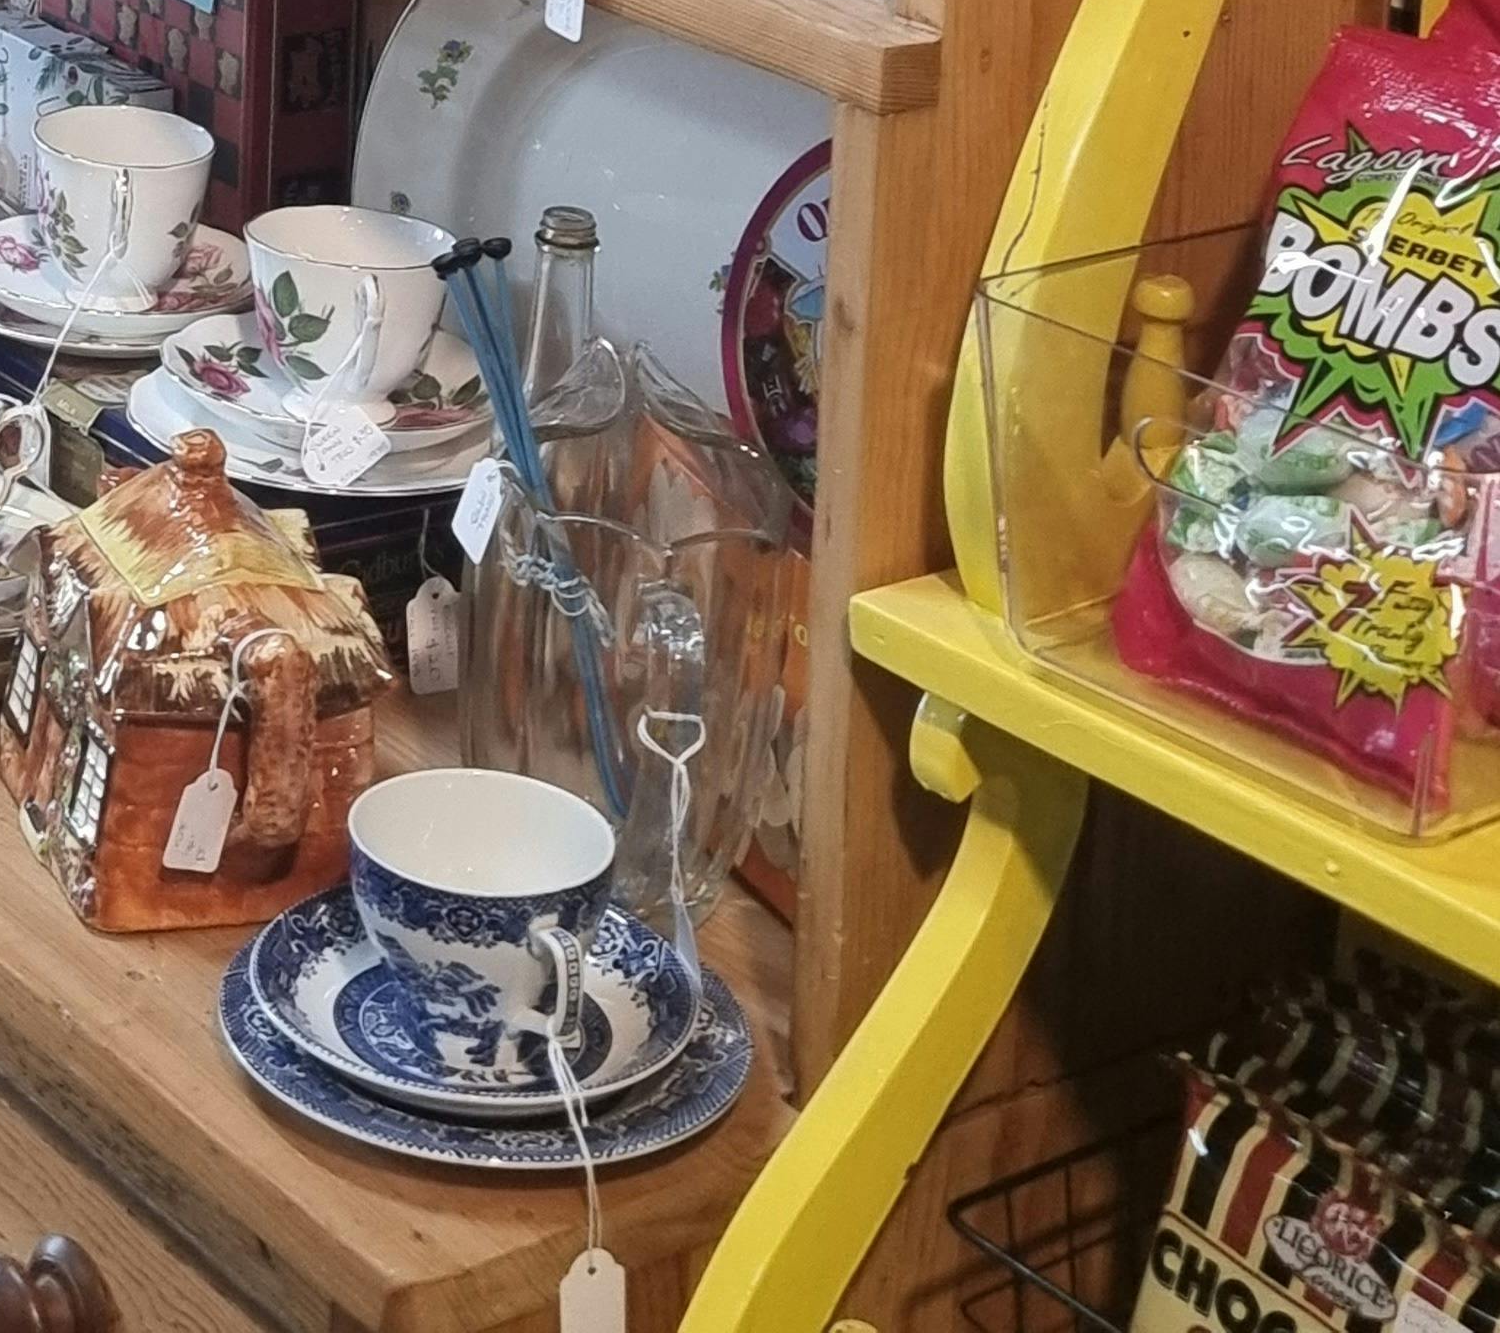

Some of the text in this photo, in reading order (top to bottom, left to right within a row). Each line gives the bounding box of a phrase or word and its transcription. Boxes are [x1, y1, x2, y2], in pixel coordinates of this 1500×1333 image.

[1281, 135, 1451, 184] Lagoon
[1347, 226, 1488, 279] SERBET
[1256, 210, 1500, 387] BOMBS
[1276, 1218, 1391, 1310] LICORICE
